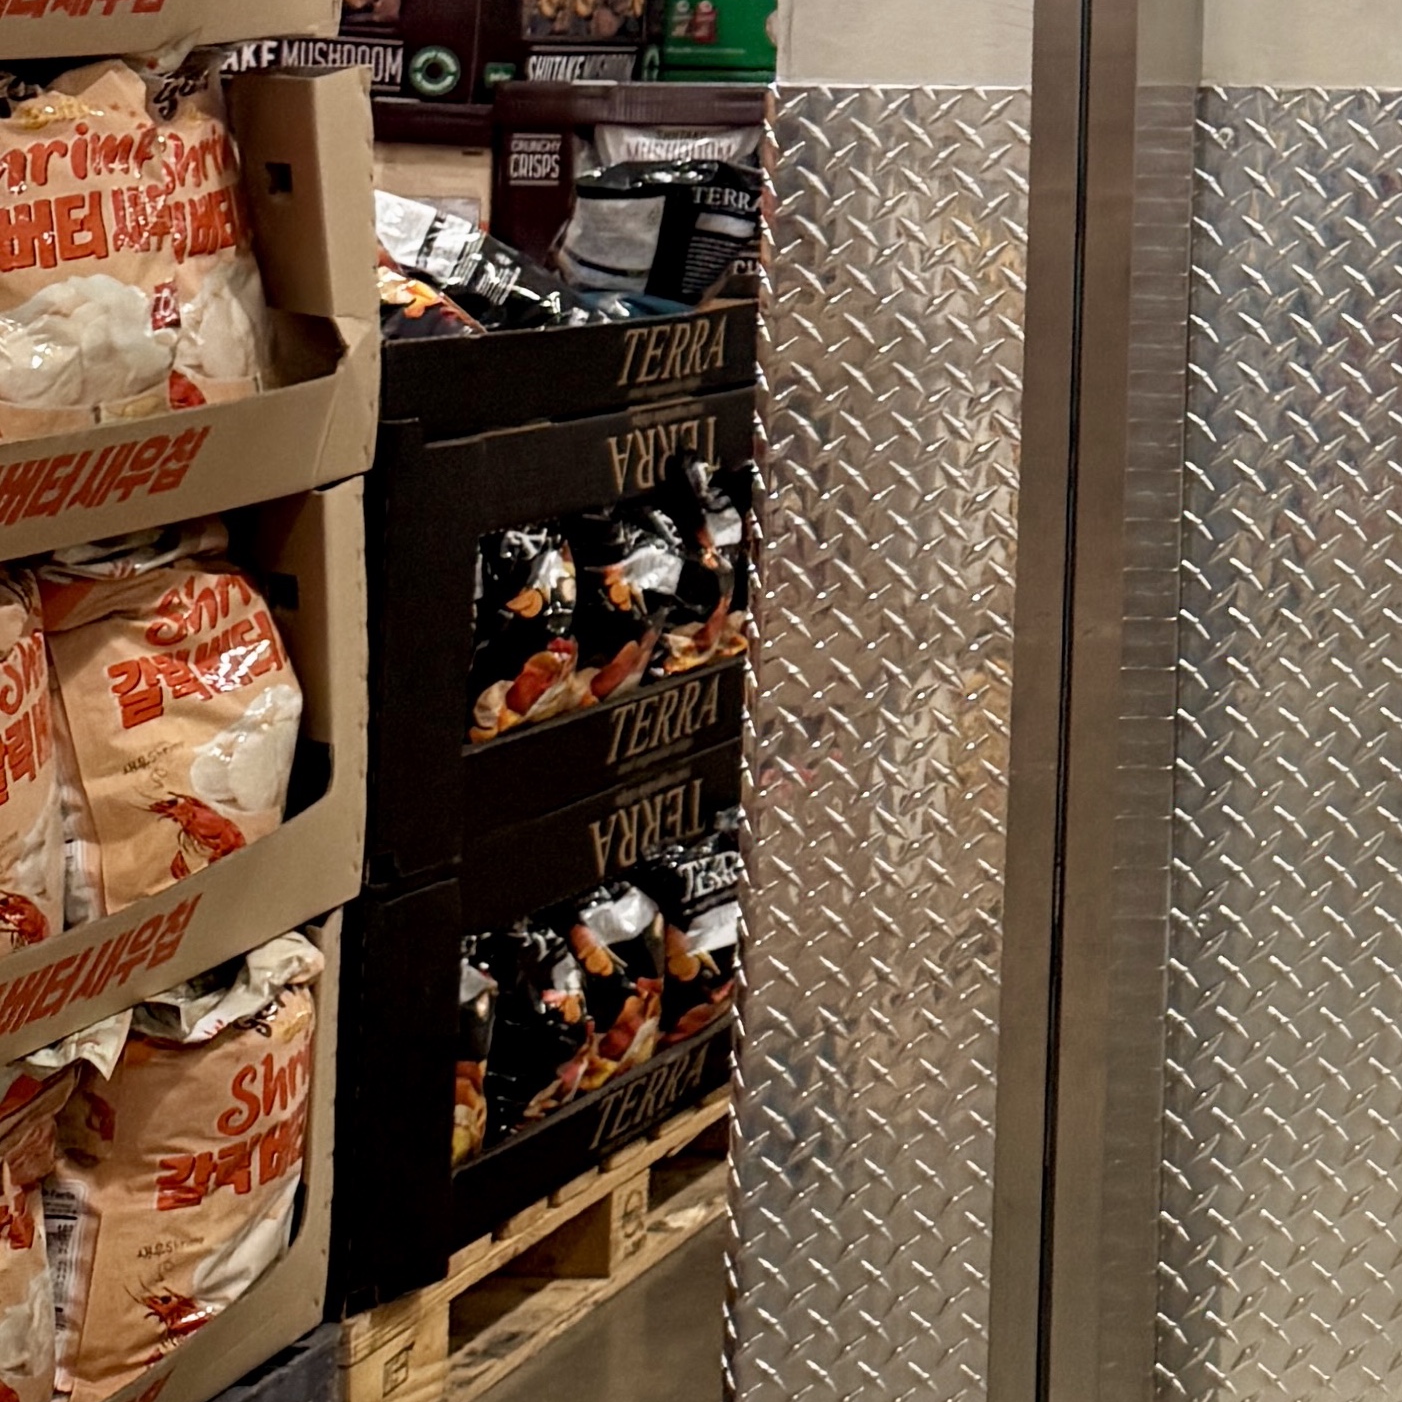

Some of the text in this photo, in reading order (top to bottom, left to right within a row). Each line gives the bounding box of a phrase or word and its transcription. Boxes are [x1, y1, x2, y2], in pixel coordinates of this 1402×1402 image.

[509, 153, 561, 179] CRISPS
[617, 319, 727, 386] TERRA
[607, 675, 720, 766] TERRA
[588, 778, 706, 876] TERRA
[589, 1043, 711, 1150] TERRA
